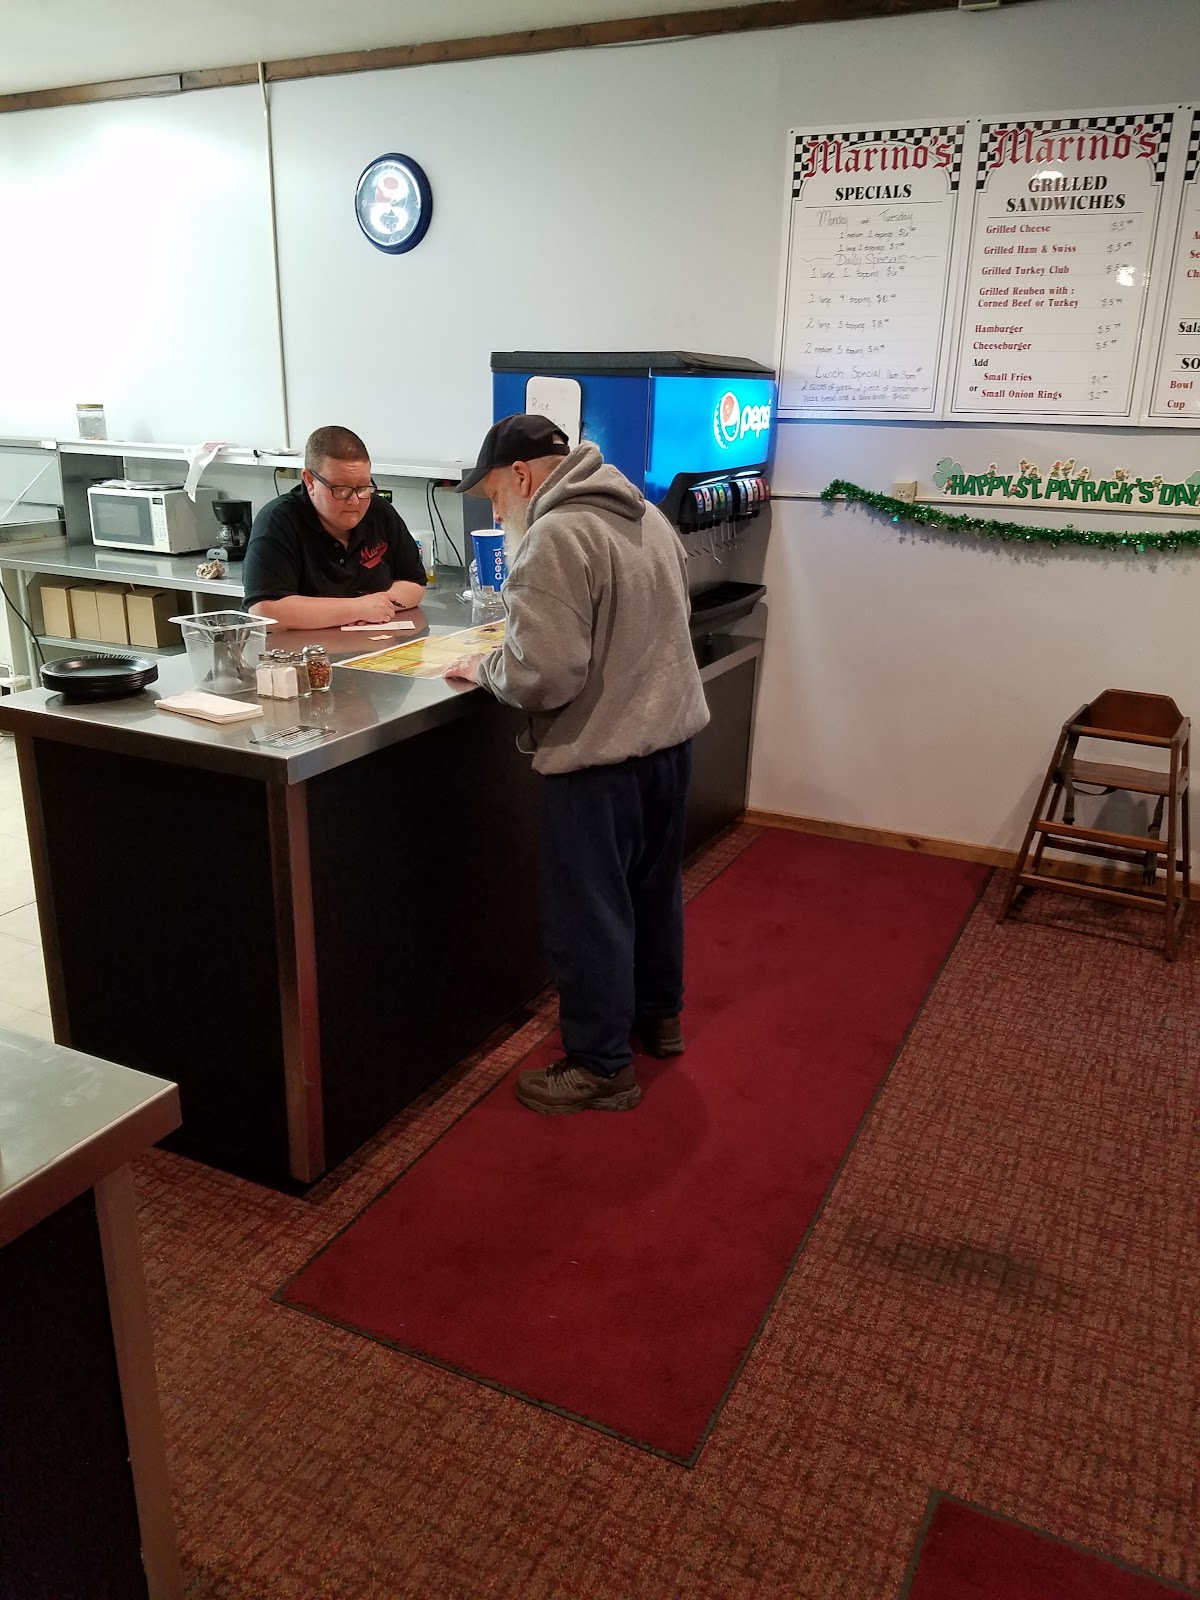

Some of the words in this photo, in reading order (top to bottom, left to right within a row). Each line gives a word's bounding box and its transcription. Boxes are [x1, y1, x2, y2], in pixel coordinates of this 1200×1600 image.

[989, 123, 1159, 169] Marino's
[803, 135, 953, 179] Marino's
[1028, 175, 1108, 193] GRILLED
[835, 184, 912, 201] SPECIALS
[1006, 193, 1126, 212] SANDWICHES
[879, 209, 914, 227] Tuesday
[986, 225, 1016, 234] Grilled
[1020, 224, 1051, 233] Cheese
[984, 245, 1014, 255] Grilled
[1017, 245, 1037, 254] Ham
[1041, 245, 1048, 253] &
[1052, 244, 1077, 253] Swiss
[834, 253, 862, 269] Daily
[982, 266, 1011, 275] Grilled
[1015, 266, 1045, 276] Turkey
[1049, 265, 1069, 274] Club
[979, 287, 1009, 296] Grilled
[1012, 286, 1045, 295] Reuben
[1049, 286, 1068, 295] with
[978, 299, 1008, 308] Corned
[1012, 298, 1032, 307] Beef
[1048, 298, 1079, 309] Turkey
[975, 325, 1024, 335] Hamburger
[973, 341, 1032, 351] Cheeseburger
[972, 358, 989, 367] Add
[815, 365, 844, 379] Lunch
[984, 372, 1007, 381] Small
[1010, 372, 1032, 381] Fries
[1170, 380, 1194, 389] Bowl
[981, 389, 1005, 398] Small
[1009, 390, 1034, 398] Onion
[1037, 390, 1063, 400] Rings
[532, 397, 550, 410] Rice
[1167, 399, 1186, 409] Cup
[951, 474, 1014, 497] HAPPY
[493, 548, 503, 580] pepsi
